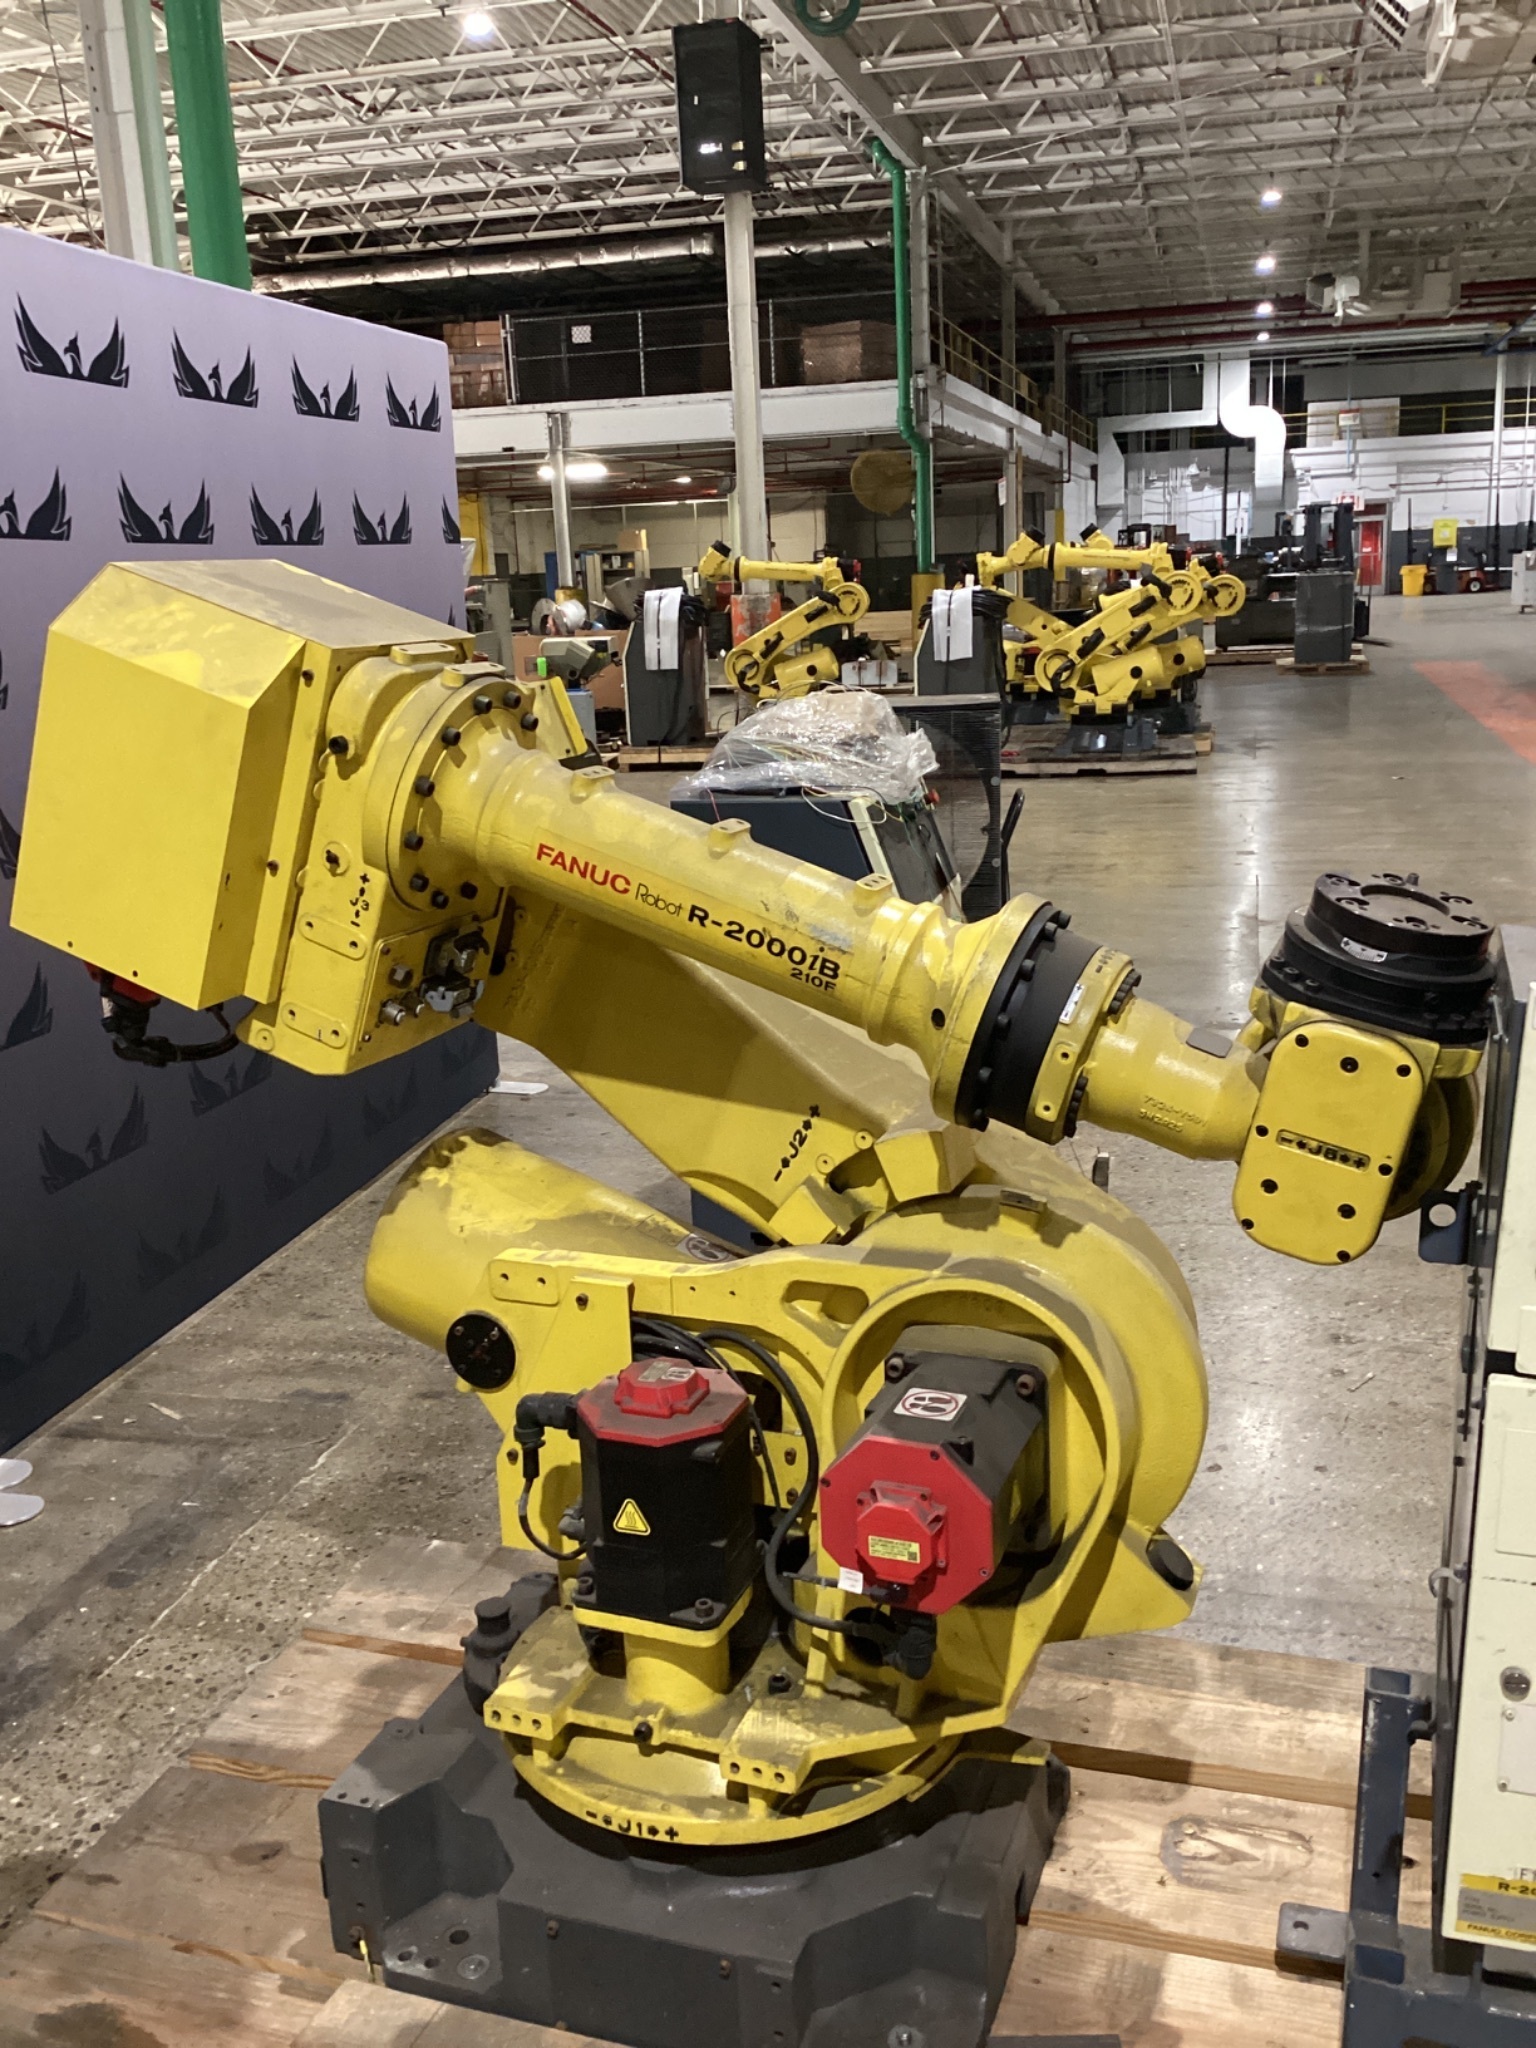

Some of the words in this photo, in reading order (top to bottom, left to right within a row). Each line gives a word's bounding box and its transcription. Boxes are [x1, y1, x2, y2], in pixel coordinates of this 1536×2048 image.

[536, 843, 631, 895] FANUC
[635, 883, 683, 917] Robot
[688, 904, 840, 980] R-2000iB
[790, 967, 836, 991] 210F
[788, 1128, 808, 1159] J2
[618, 1819, 642, 1836] J1
